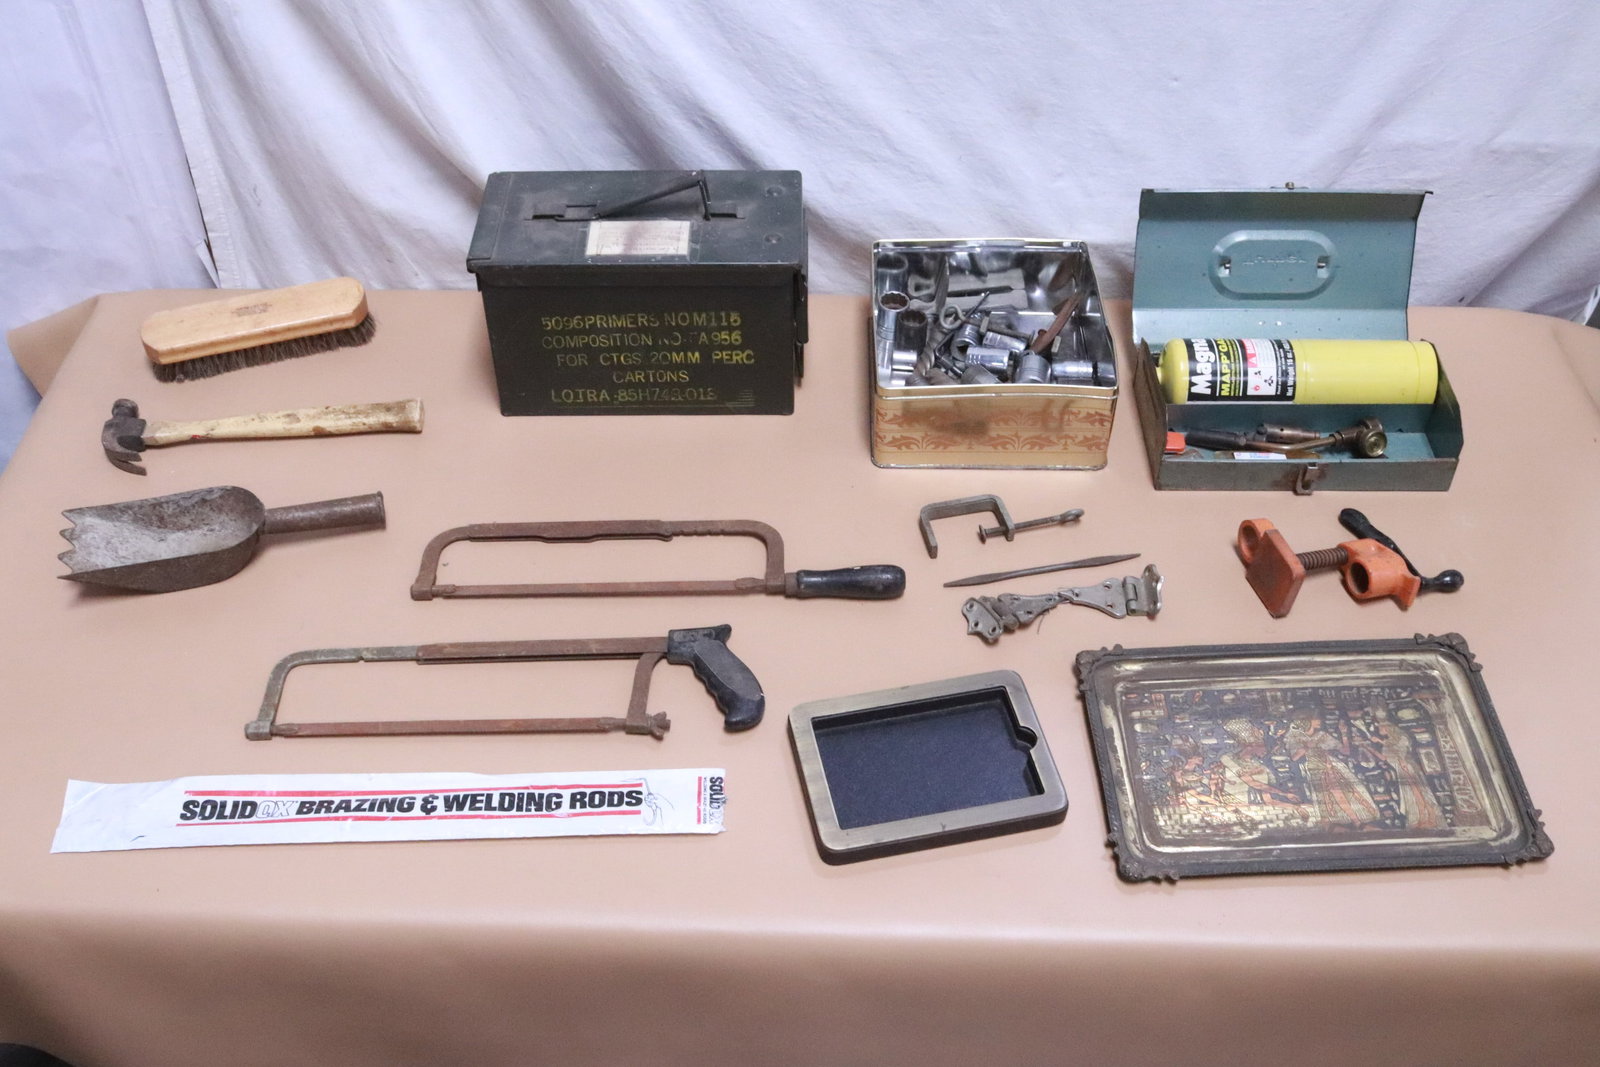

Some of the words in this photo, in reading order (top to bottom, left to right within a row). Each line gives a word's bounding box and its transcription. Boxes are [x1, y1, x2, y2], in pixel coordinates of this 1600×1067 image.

[542, 332, 652, 349] COMPOSITION
[556, 353, 588, 367] FOR
[600, 352, 642, 366] CTGS
[651, 351, 701, 364] 20MM
[712, 349, 755, 364] PERC
[612, 370, 689, 383] CARTONS
[295, 796, 417, 816] BRAZING
[420, 794, 438, 815] &
[444, 792, 564, 813] WELDING
[569, 790, 643, 809] RODS
